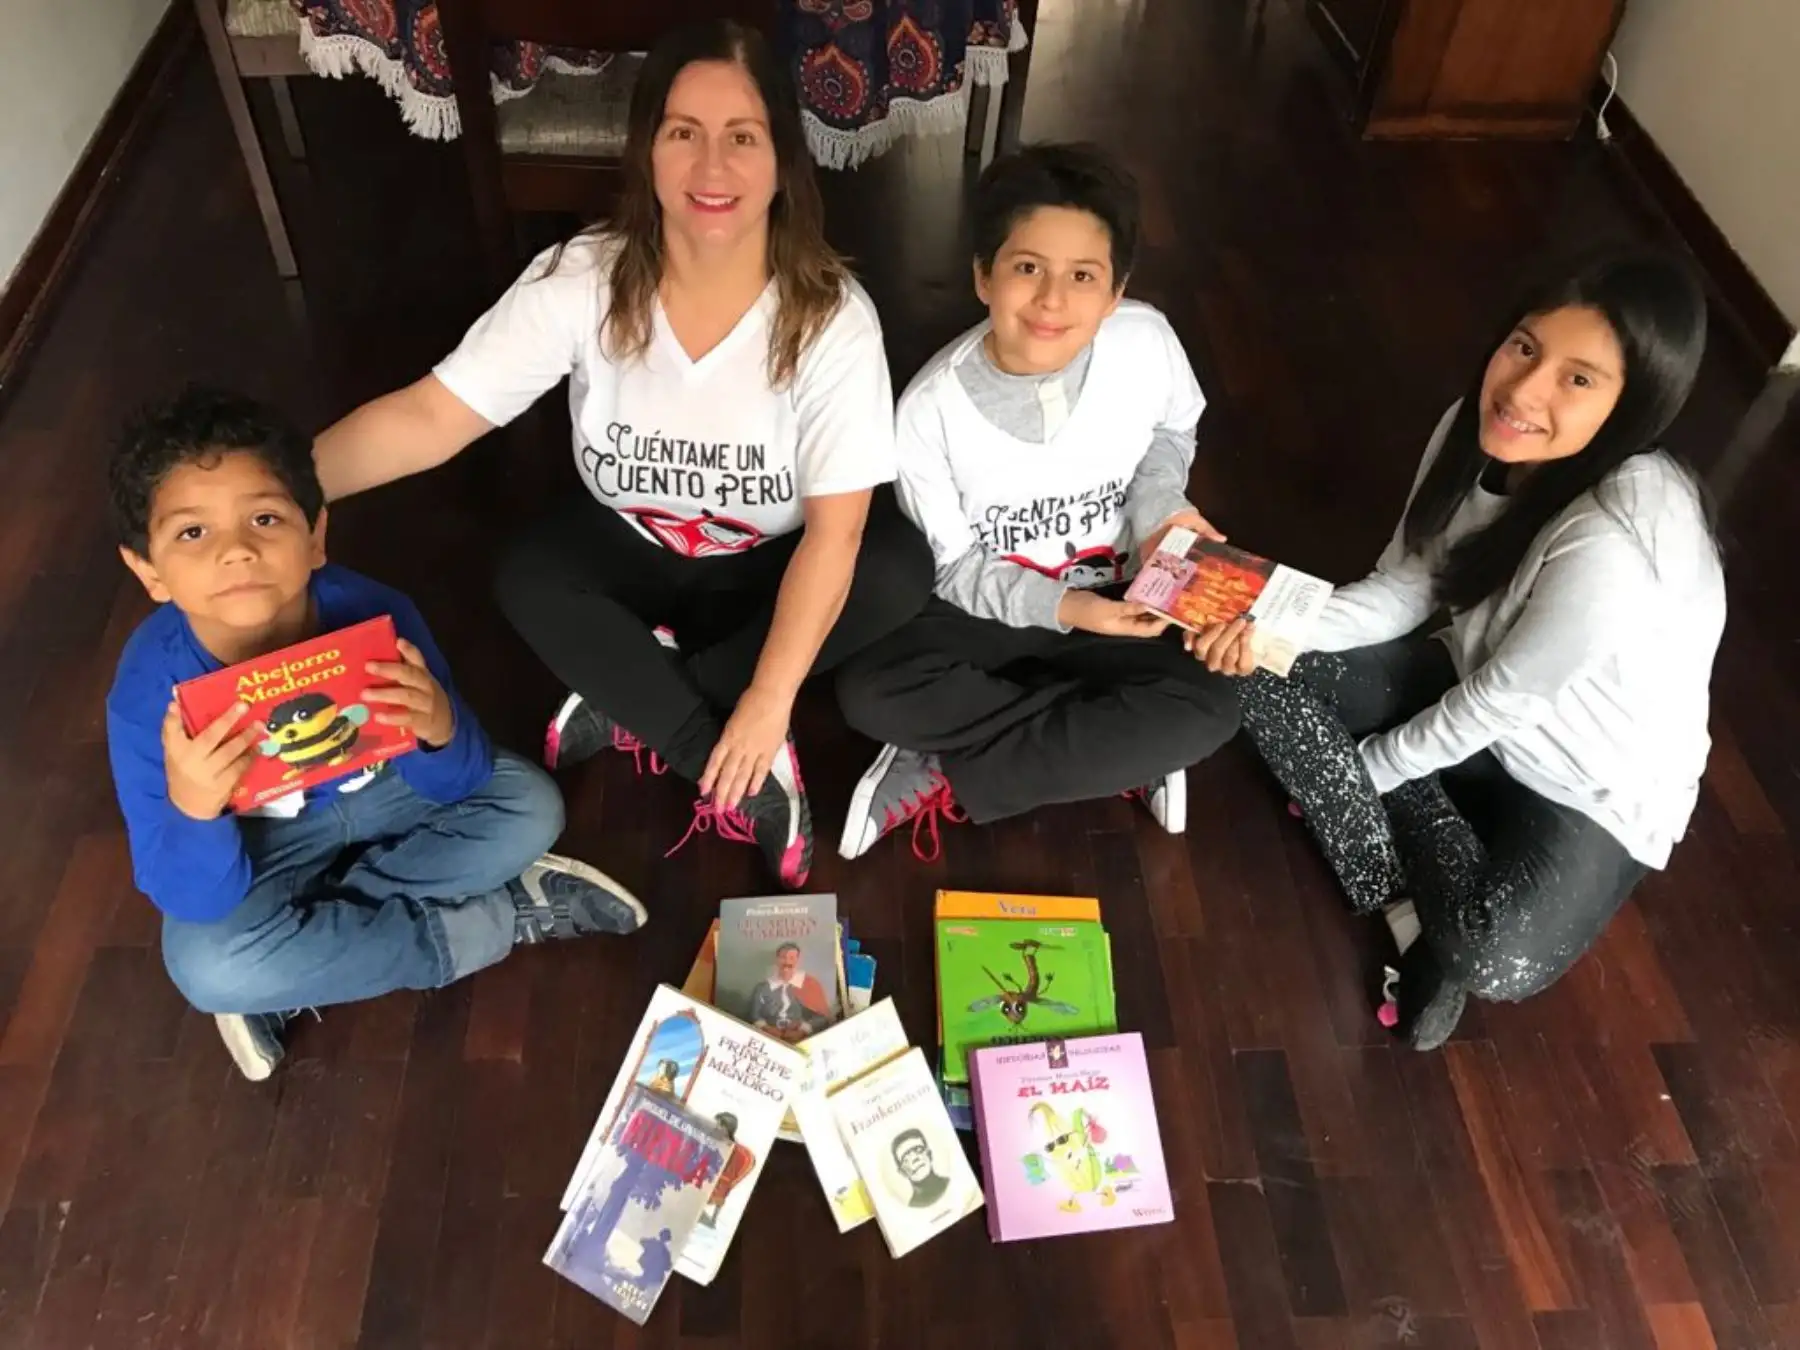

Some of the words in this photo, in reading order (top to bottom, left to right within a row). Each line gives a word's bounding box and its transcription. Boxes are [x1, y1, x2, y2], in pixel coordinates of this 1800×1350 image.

[607, 421, 729, 471] CUÉNTAME
[737, 444, 765, 471] UN
[582, 446, 704, 498] CUENTO
[715, 466, 794, 507] PERÚ
[235, 648, 341, 692] Abejorro
[238, 663, 347, 704] Modorro
[747, 1036, 769, 1056] EL
[707, 1056, 785, 1103] MENDIGO
[745, 1062, 768, 1082] EL
[1017, 1085, 1043, 1098] EL
